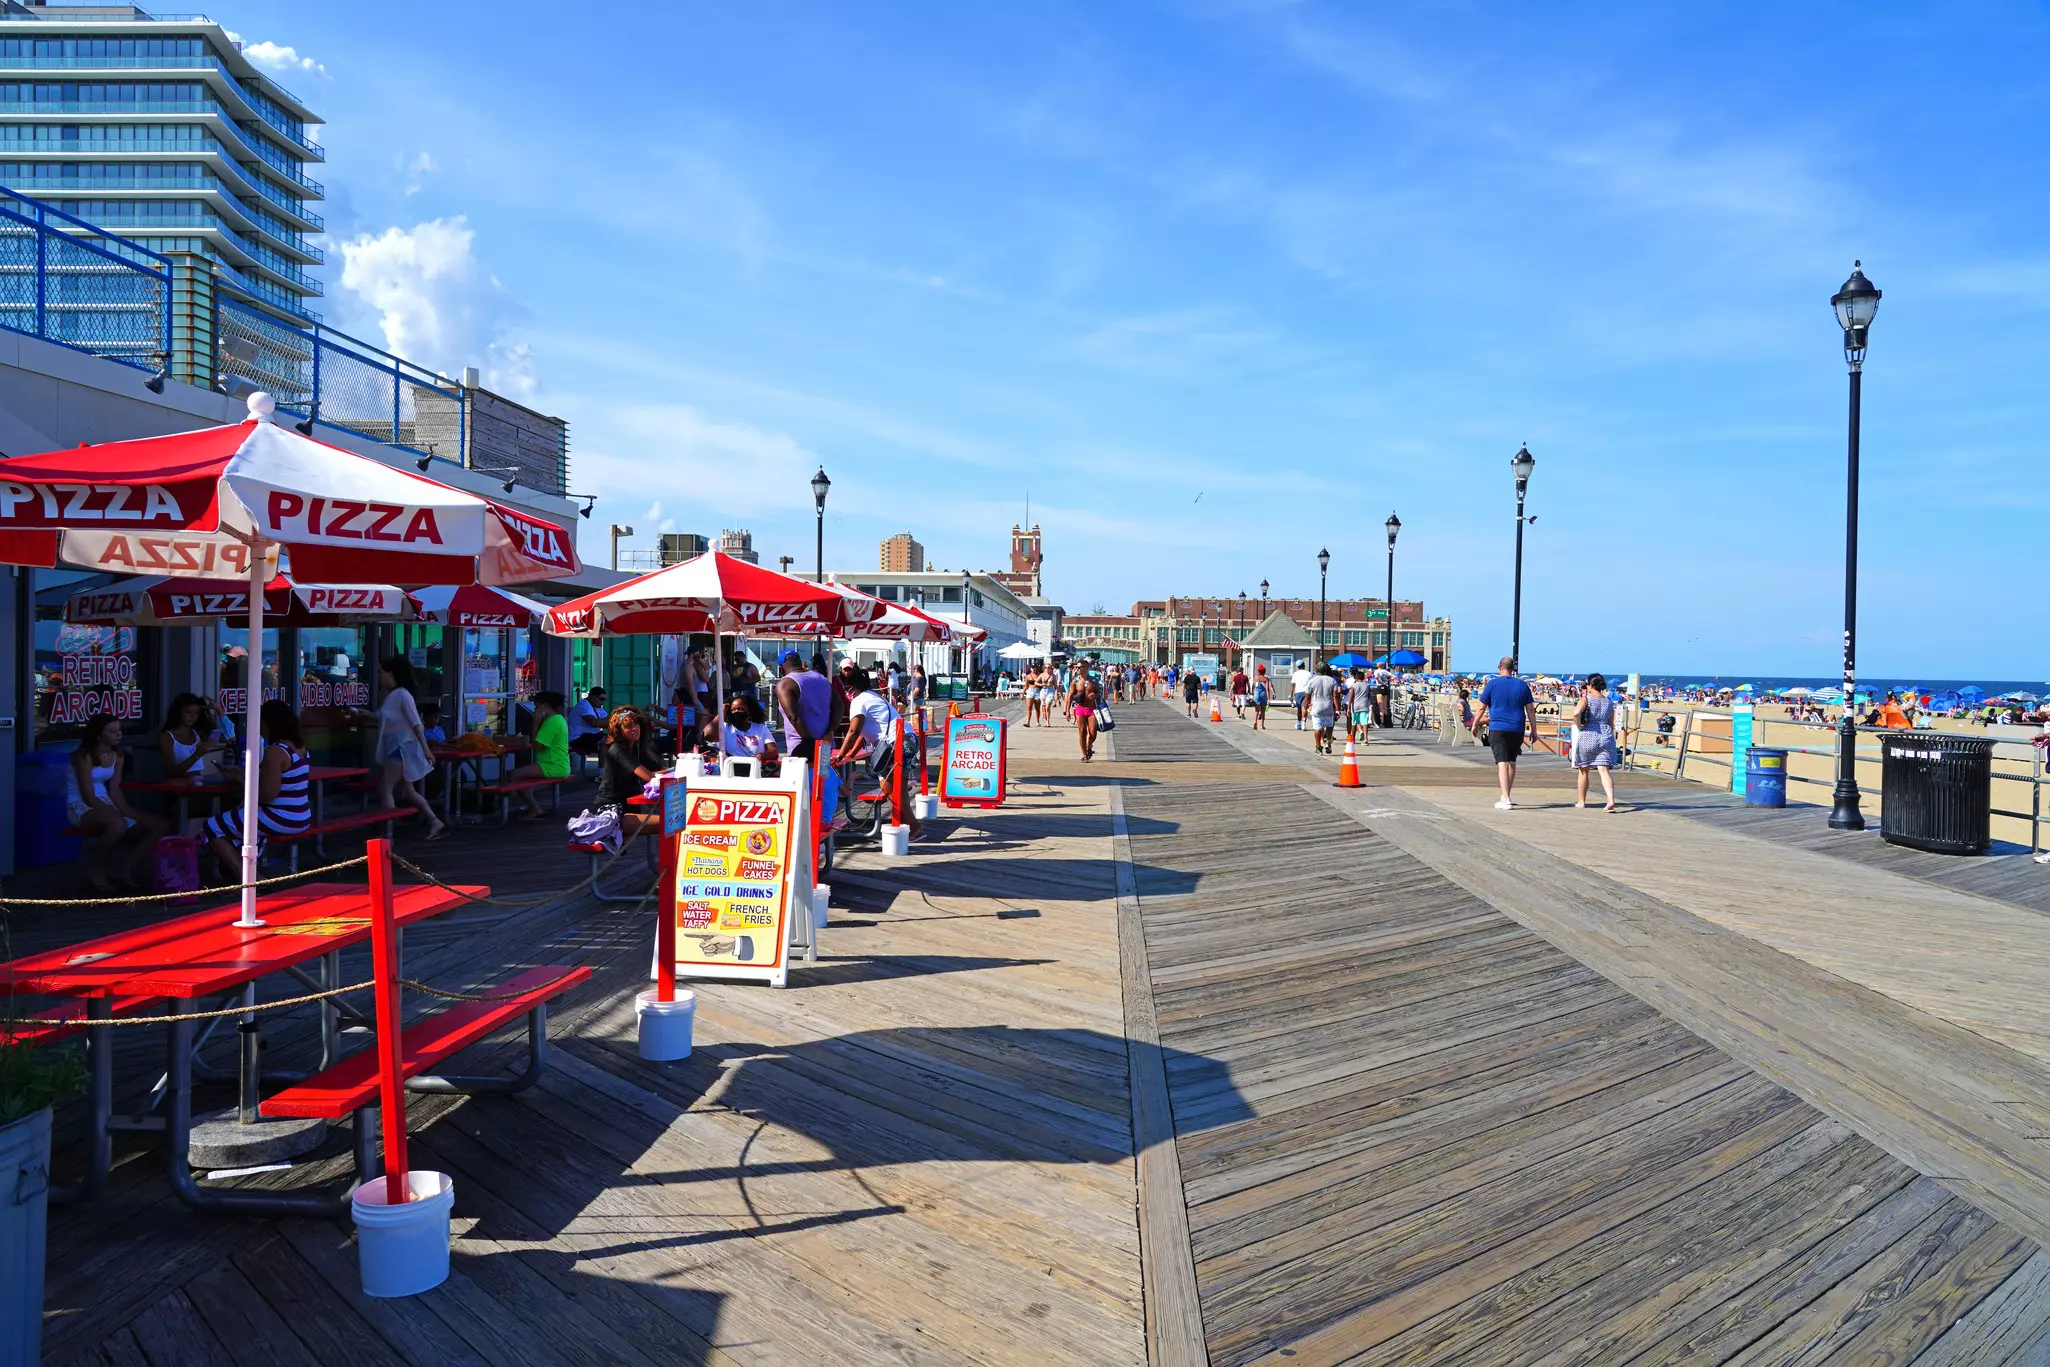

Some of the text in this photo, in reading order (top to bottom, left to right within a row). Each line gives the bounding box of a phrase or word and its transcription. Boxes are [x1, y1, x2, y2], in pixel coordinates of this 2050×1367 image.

[0, 482, 184, 521] PIZZA
[267, 490, 444, 545] PIZZA
[78, 593, 134, 617] PIZZA
[170, 594, 271, 614] PIZZ
[309, 589, 384, 609] PIZZA
[616, 596, 709, 611] PIZZA
[460, 612, 516, 626] PIZZA
[740, 602, 819, 622] PIZZA
[853, 622, 911, 636] PIZZA
[62, 655, 132, 686] RETRO
[299, 682, 370, 708] VIDEO GAMES
[50, 689, 143, 724] ARCADE
[955, 750, 993, 760] RETRO
[950, 760, 997, 770] ARCADE
[719, 800, 784, 824] PIZZA
[683, 833, 701, 845] ICE
[702, 835, 738, 847] CREAM
[687, 867, 728, 876] HOT DOGS
[741, 860, 777, 871] FUNNEL
[743, 869, 774, 880] CAKES
[682, 884, 774, 899] ICE COLD DRINKS
[687, 900, 710, 911] SALT
[729, 904, 769, 915] FRENCH
[682, 910, 712, 921] WATER
[744, 914, 773, 925] FRIES
[683, 919, 709, 930] TAFFY
